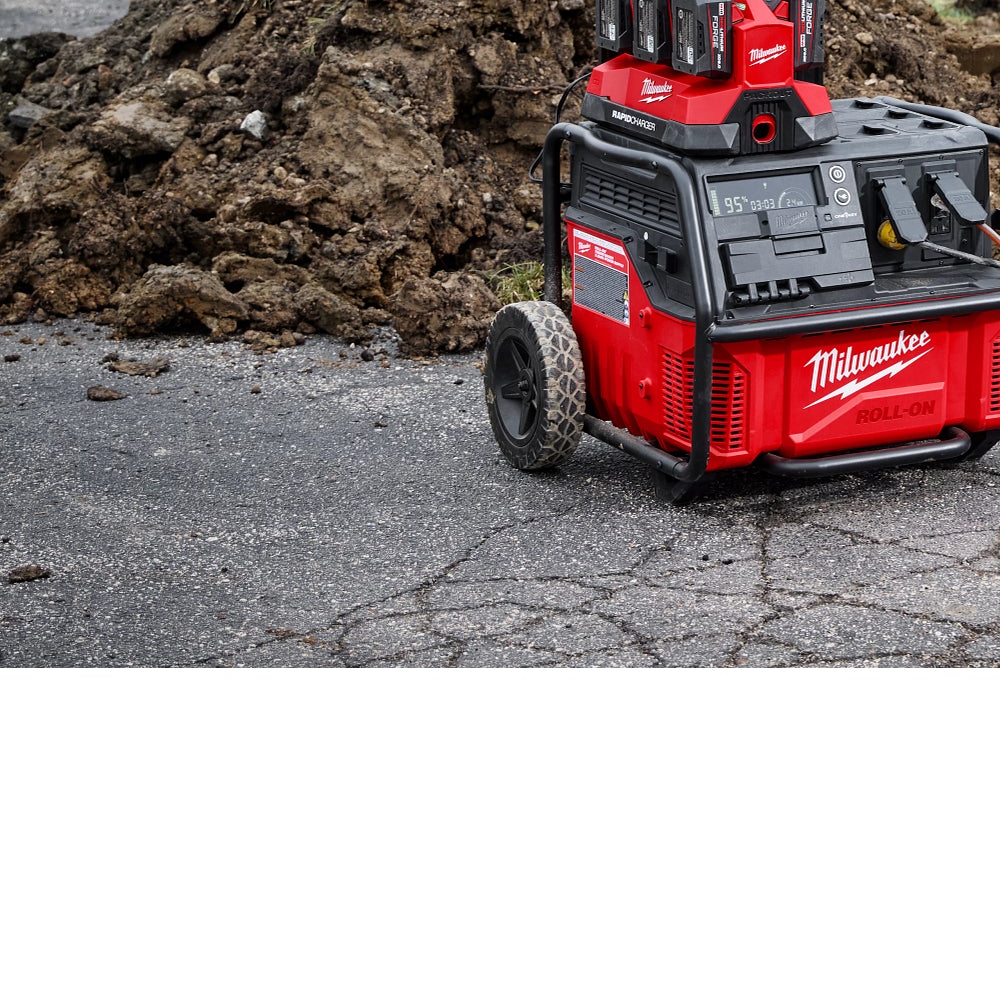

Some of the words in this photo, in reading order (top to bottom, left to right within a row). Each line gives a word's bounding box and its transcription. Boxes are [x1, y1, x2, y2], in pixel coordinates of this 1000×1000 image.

[748, 44, 787, 62] Milwaukee
[640, 77, 673, 96] Milwaukee
[750, 198, 776, 211] 03:03
[803, 329, 931, 393] Milwaukee
[855, 400, 936, 425] ROLL-ON
